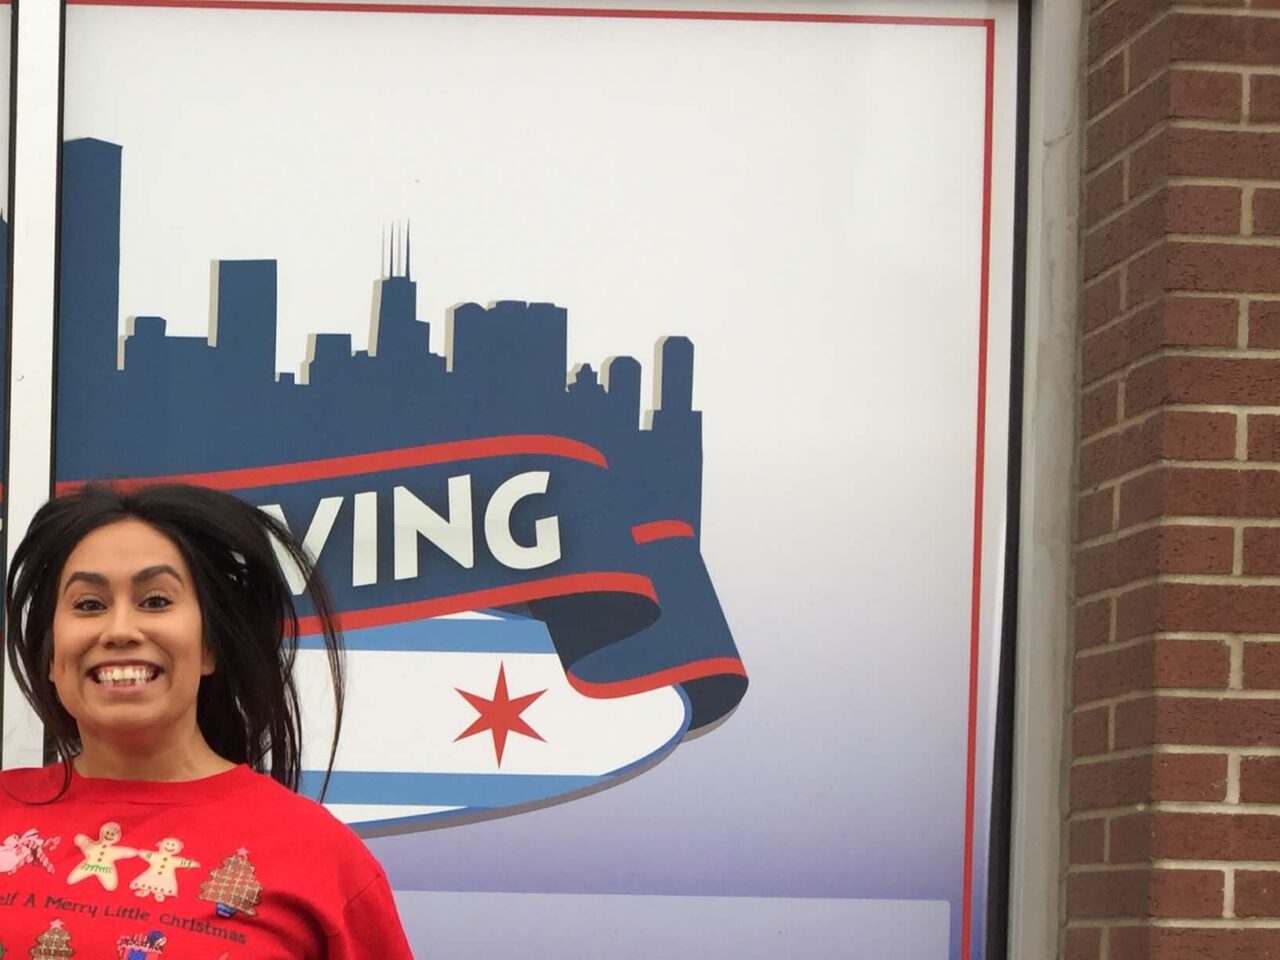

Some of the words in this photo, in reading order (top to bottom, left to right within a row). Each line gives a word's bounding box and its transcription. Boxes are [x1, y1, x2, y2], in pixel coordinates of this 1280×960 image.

[257, 470, 562, 597] VING
[24, 893, 36, 908] A
[44, 895, 99, 918] Merry
[103, 904, 151, 922] Little
[158, 912, 247, 945] Christmas
